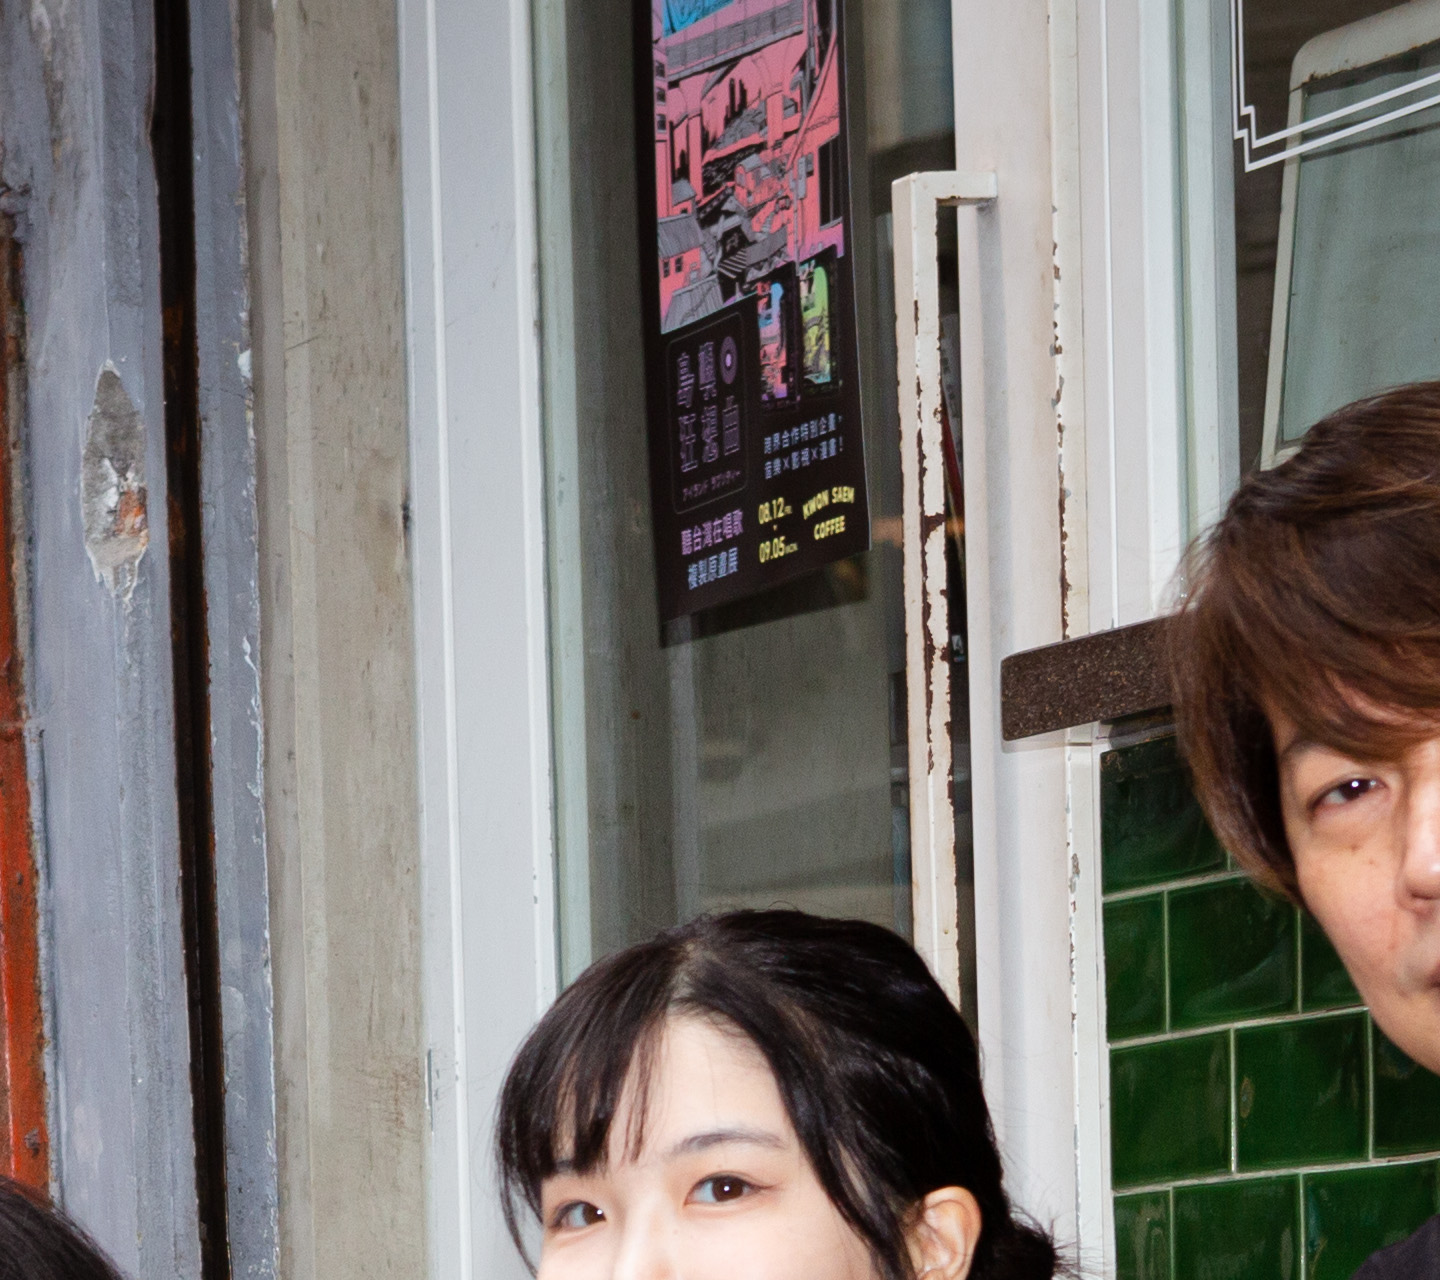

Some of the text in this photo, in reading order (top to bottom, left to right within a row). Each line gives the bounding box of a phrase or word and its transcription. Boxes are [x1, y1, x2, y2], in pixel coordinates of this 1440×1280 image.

[802, 485, 855, 520] KWON SAEM
[813, 515, 846, 540] COFFEE
[758, 535, 785, 563] 09.05
